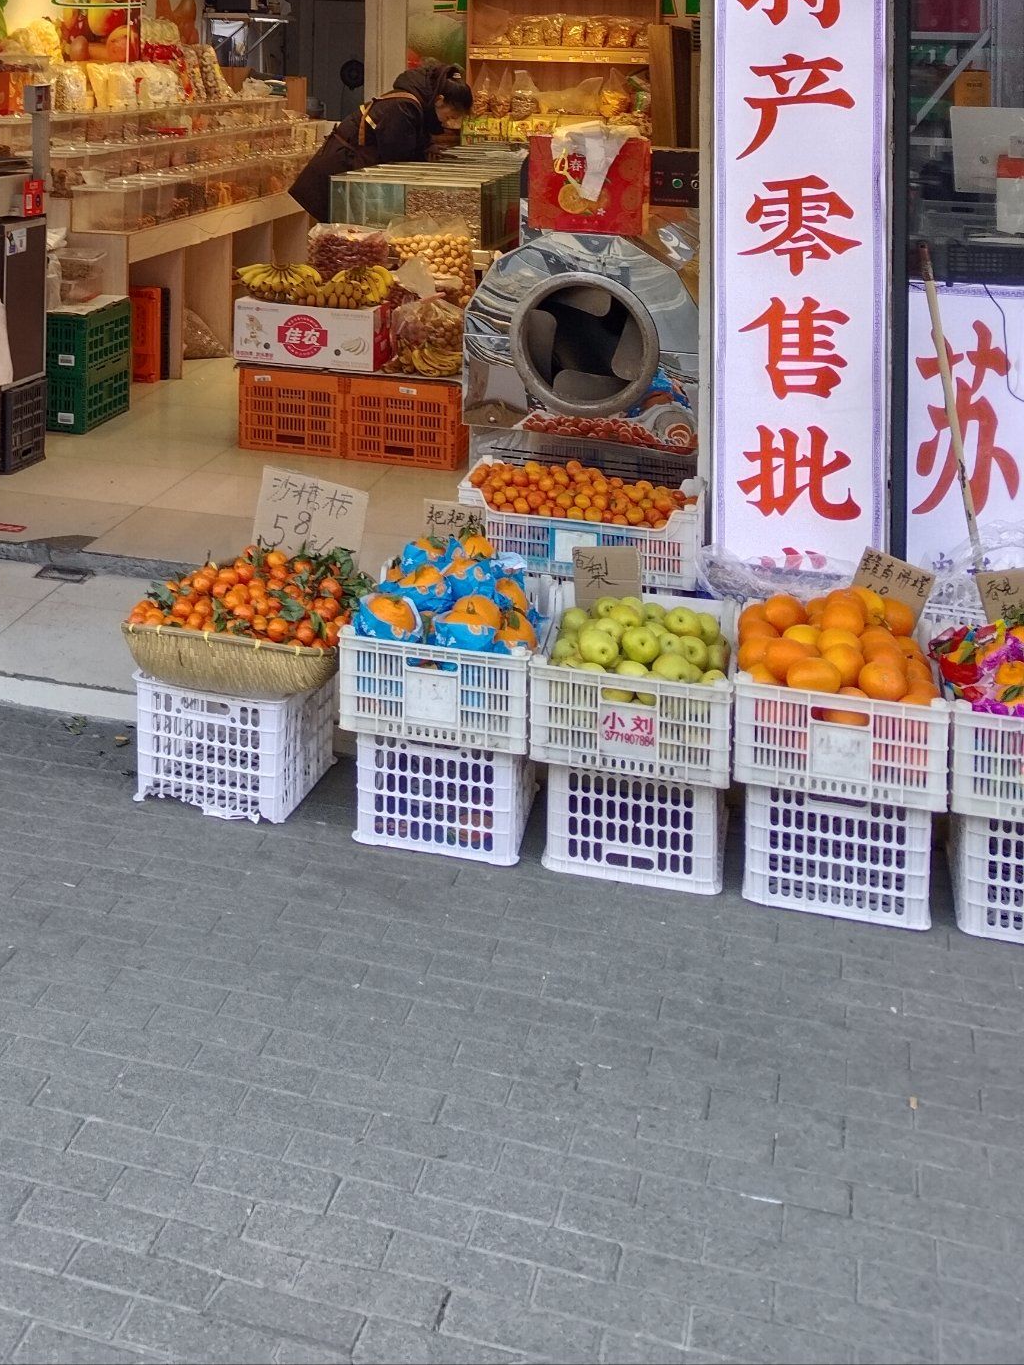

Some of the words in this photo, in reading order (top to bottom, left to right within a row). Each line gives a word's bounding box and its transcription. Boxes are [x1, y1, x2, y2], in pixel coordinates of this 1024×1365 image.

[284, 327, 321, 346] 佳农
[912, 320, 1021, 516] 苏
[603, 711, 654, 735] 小刘
